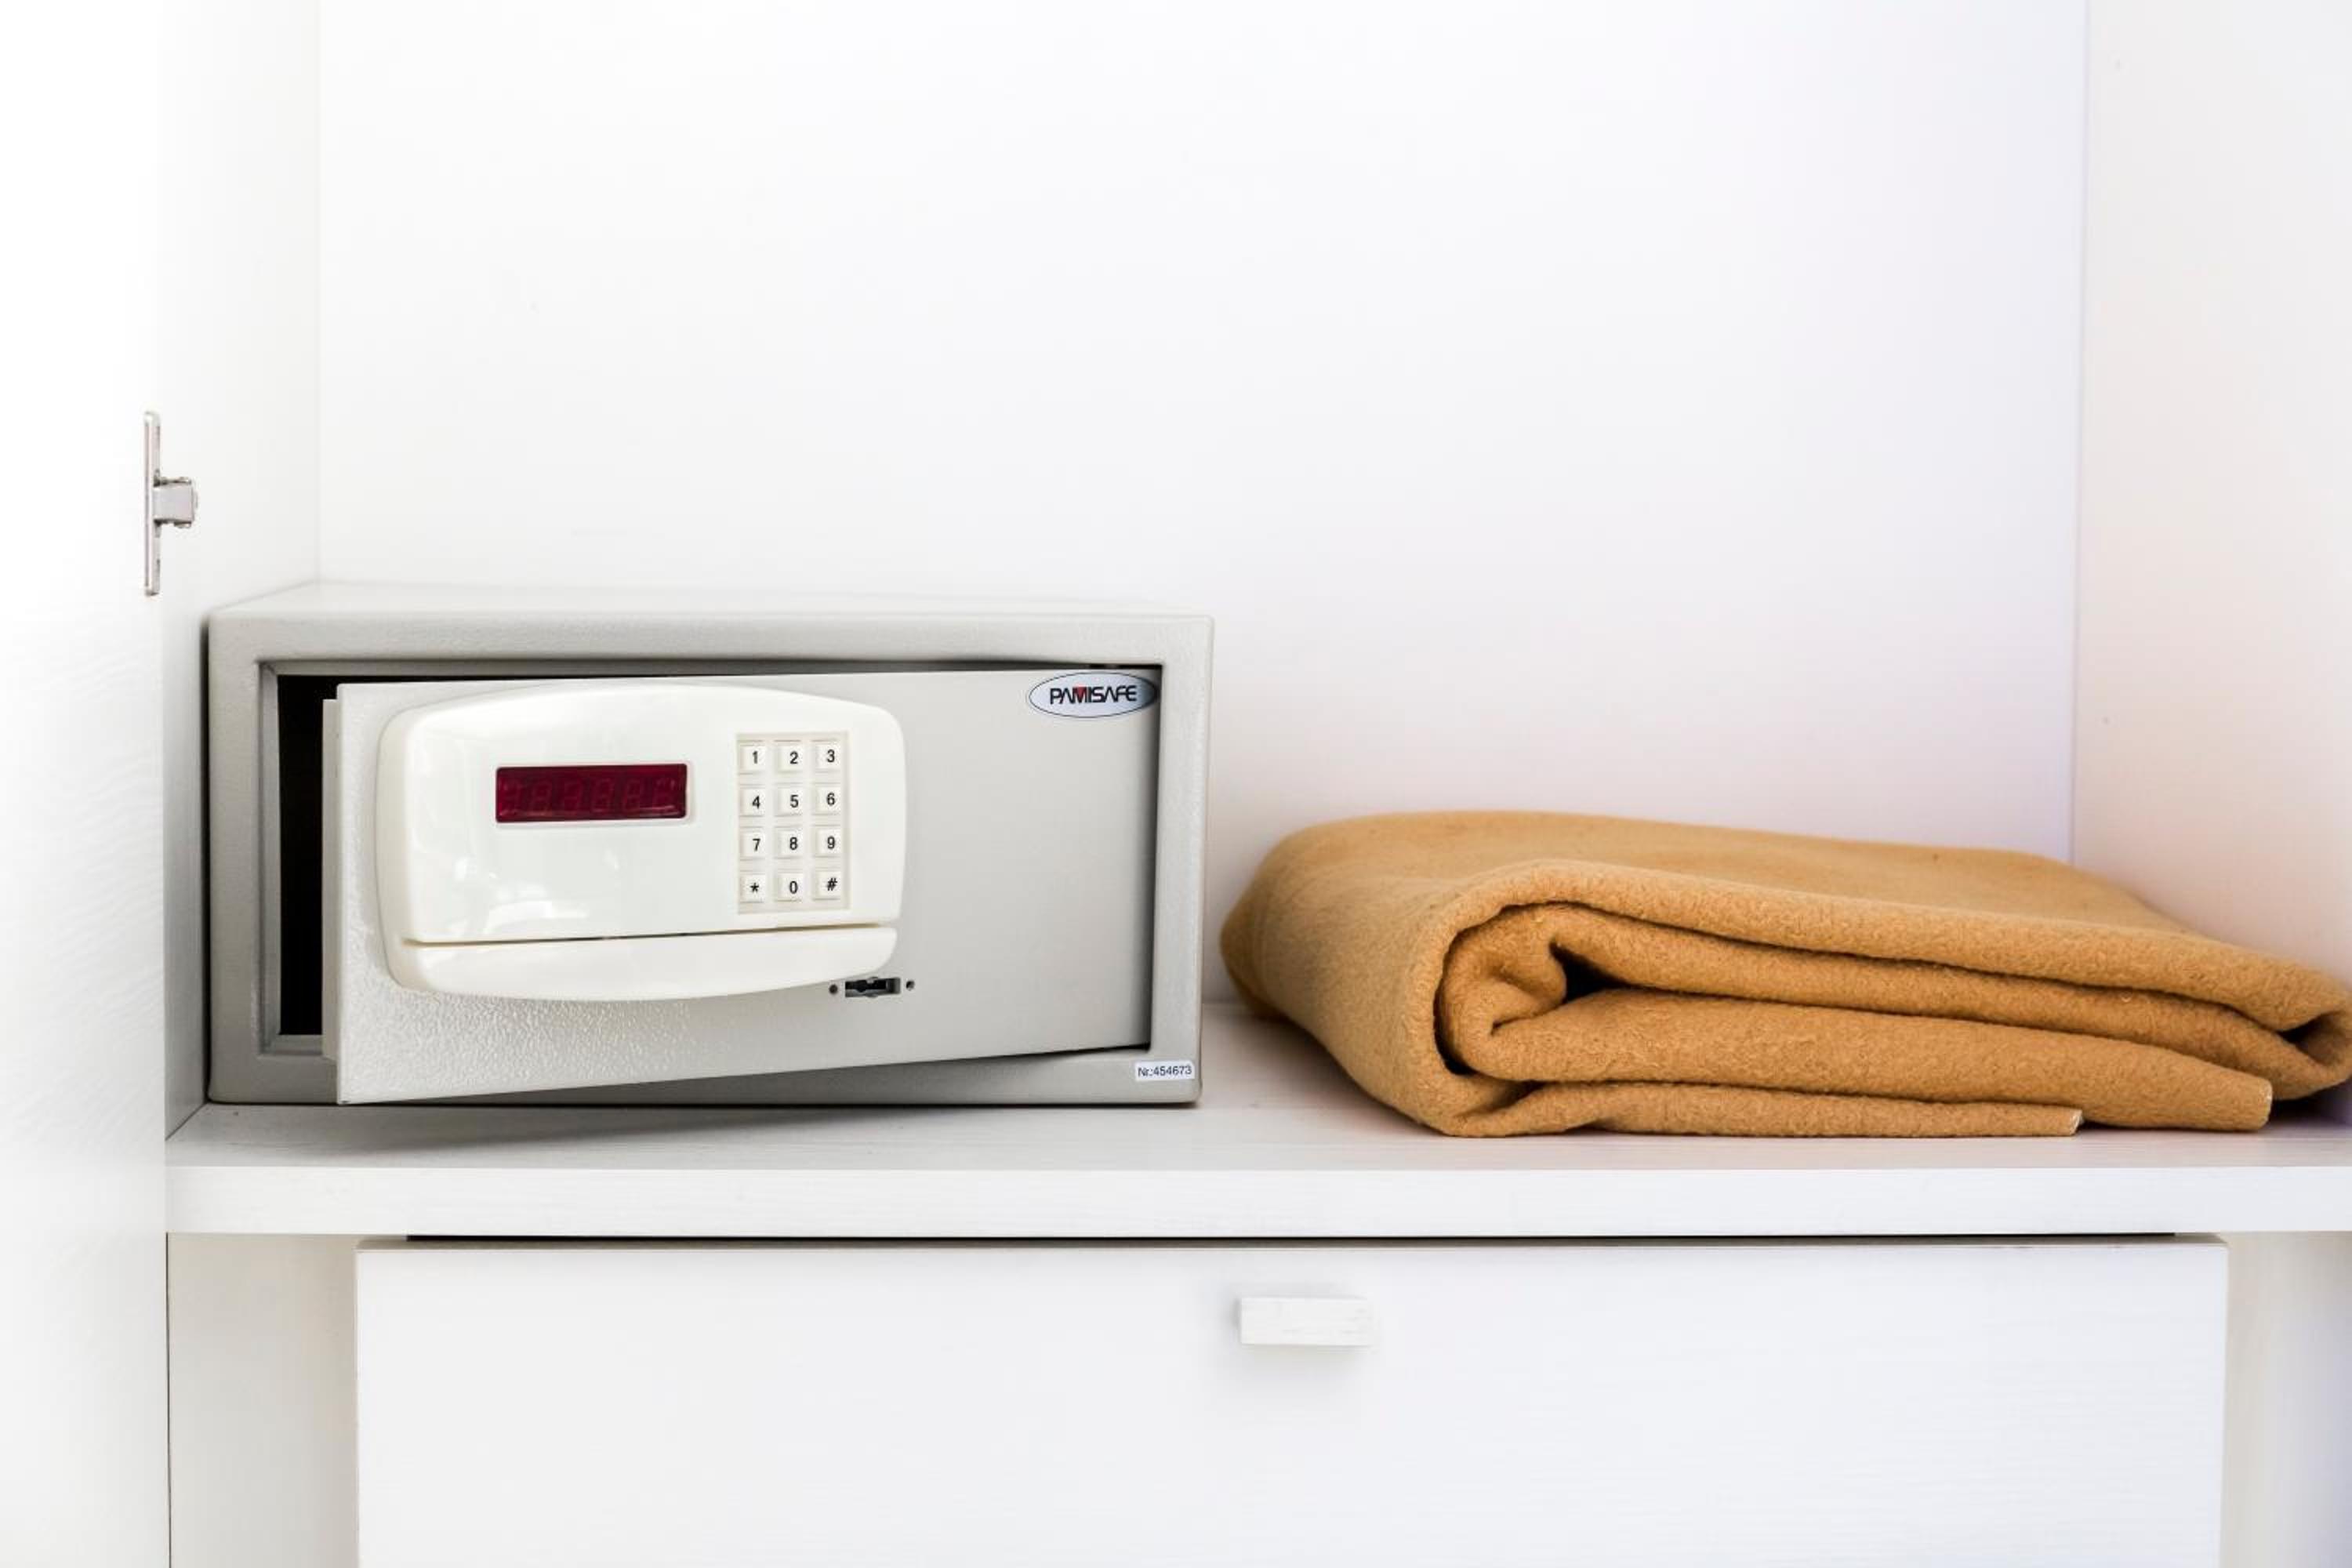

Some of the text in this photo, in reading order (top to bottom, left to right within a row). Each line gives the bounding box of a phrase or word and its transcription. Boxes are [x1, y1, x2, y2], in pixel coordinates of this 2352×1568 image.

[1049, 684, 1138, 705] PAMISAFE
[752, 749, 836, 764] 1 2 3
[752, 792, 836, 809] 4 5 6
[752, 836, 836, 851] 7 8 9
[789, 880, 798, 895] 0
